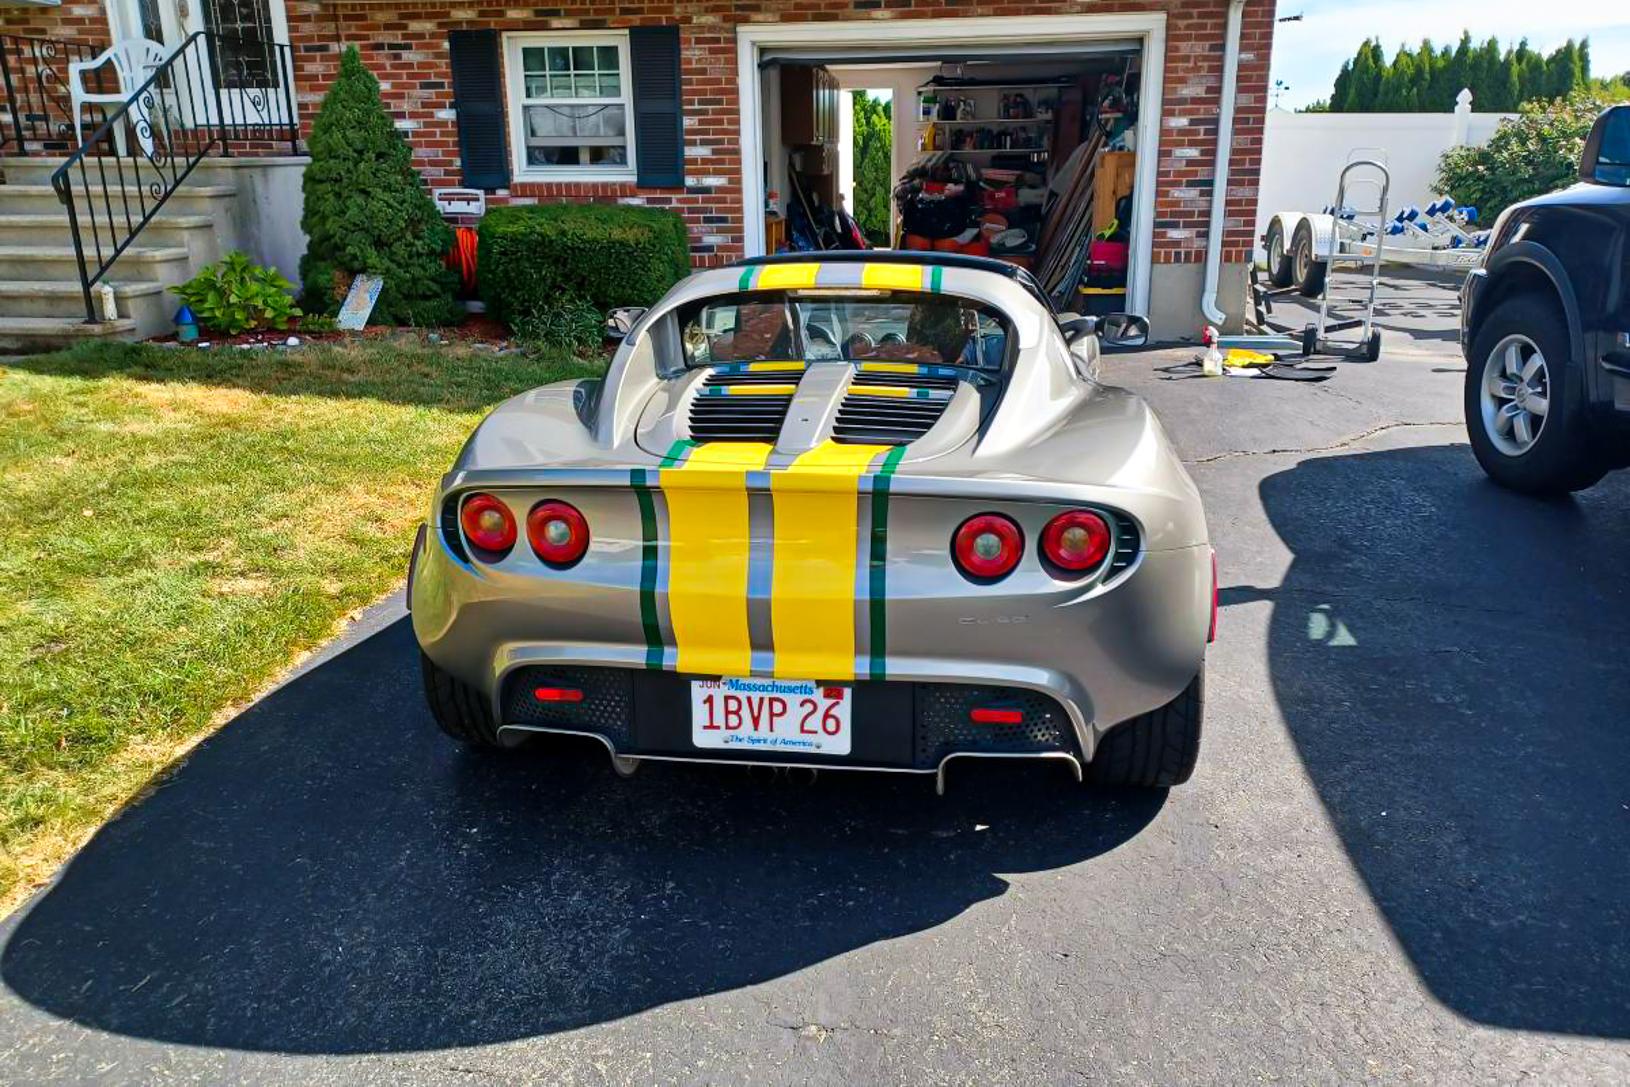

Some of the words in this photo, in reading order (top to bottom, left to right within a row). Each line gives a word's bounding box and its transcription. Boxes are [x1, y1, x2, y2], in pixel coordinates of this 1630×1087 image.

[727, 679, 814, 695] Massachusetts
[703, 694, 787, 732] 1BVP
[800, 698, 841, 735] 26
[730, 734, 745, 743] The
[747, 736, 768, 745] Spirit
[770, 738, 778, 746] of
[780, 738, 813, 747] America
